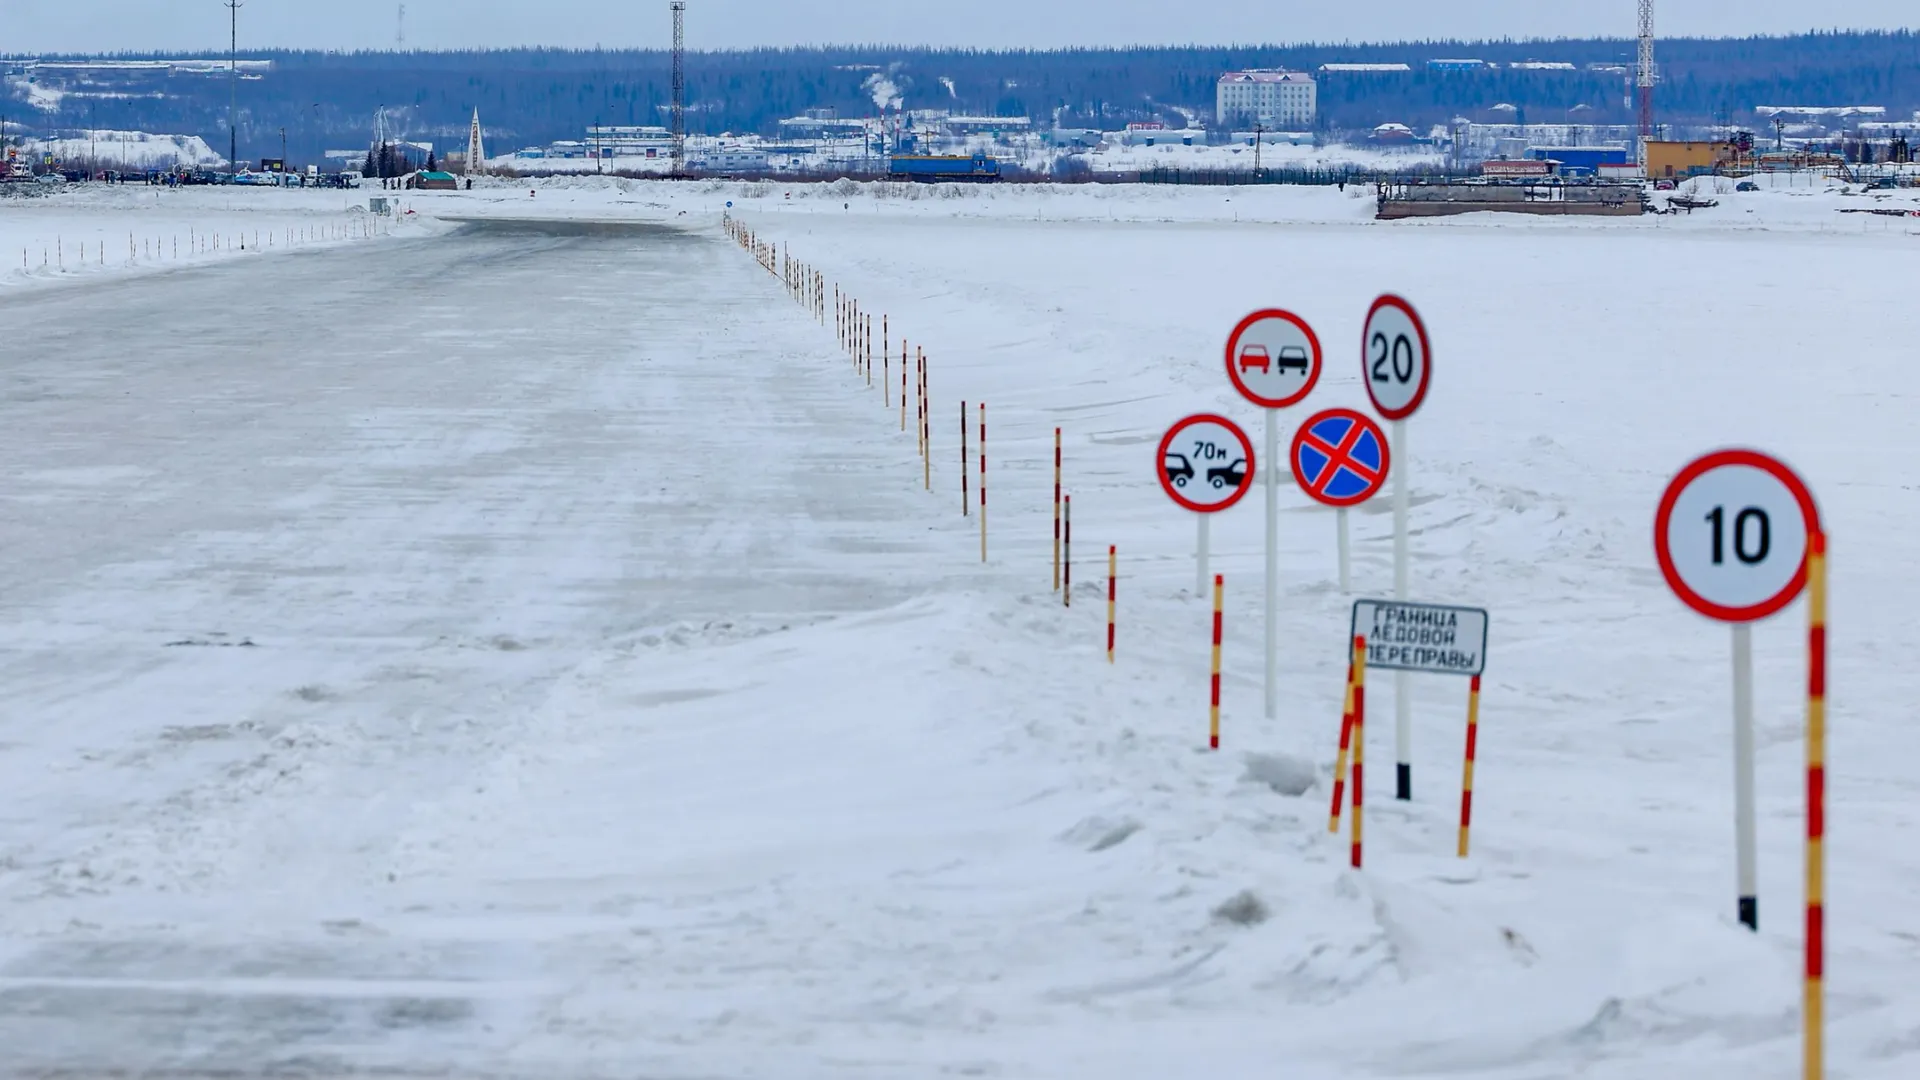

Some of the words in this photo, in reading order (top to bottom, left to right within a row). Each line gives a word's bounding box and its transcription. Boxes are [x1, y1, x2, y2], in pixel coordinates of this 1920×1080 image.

[1372, 332, 1413, 383] 20
[1705, 505, 1770, 566] 10
[1374, 606, 1458, 626] ГРАНИЦА
[1371, 626, 1455, 646] ЛЕДОВОЙ
